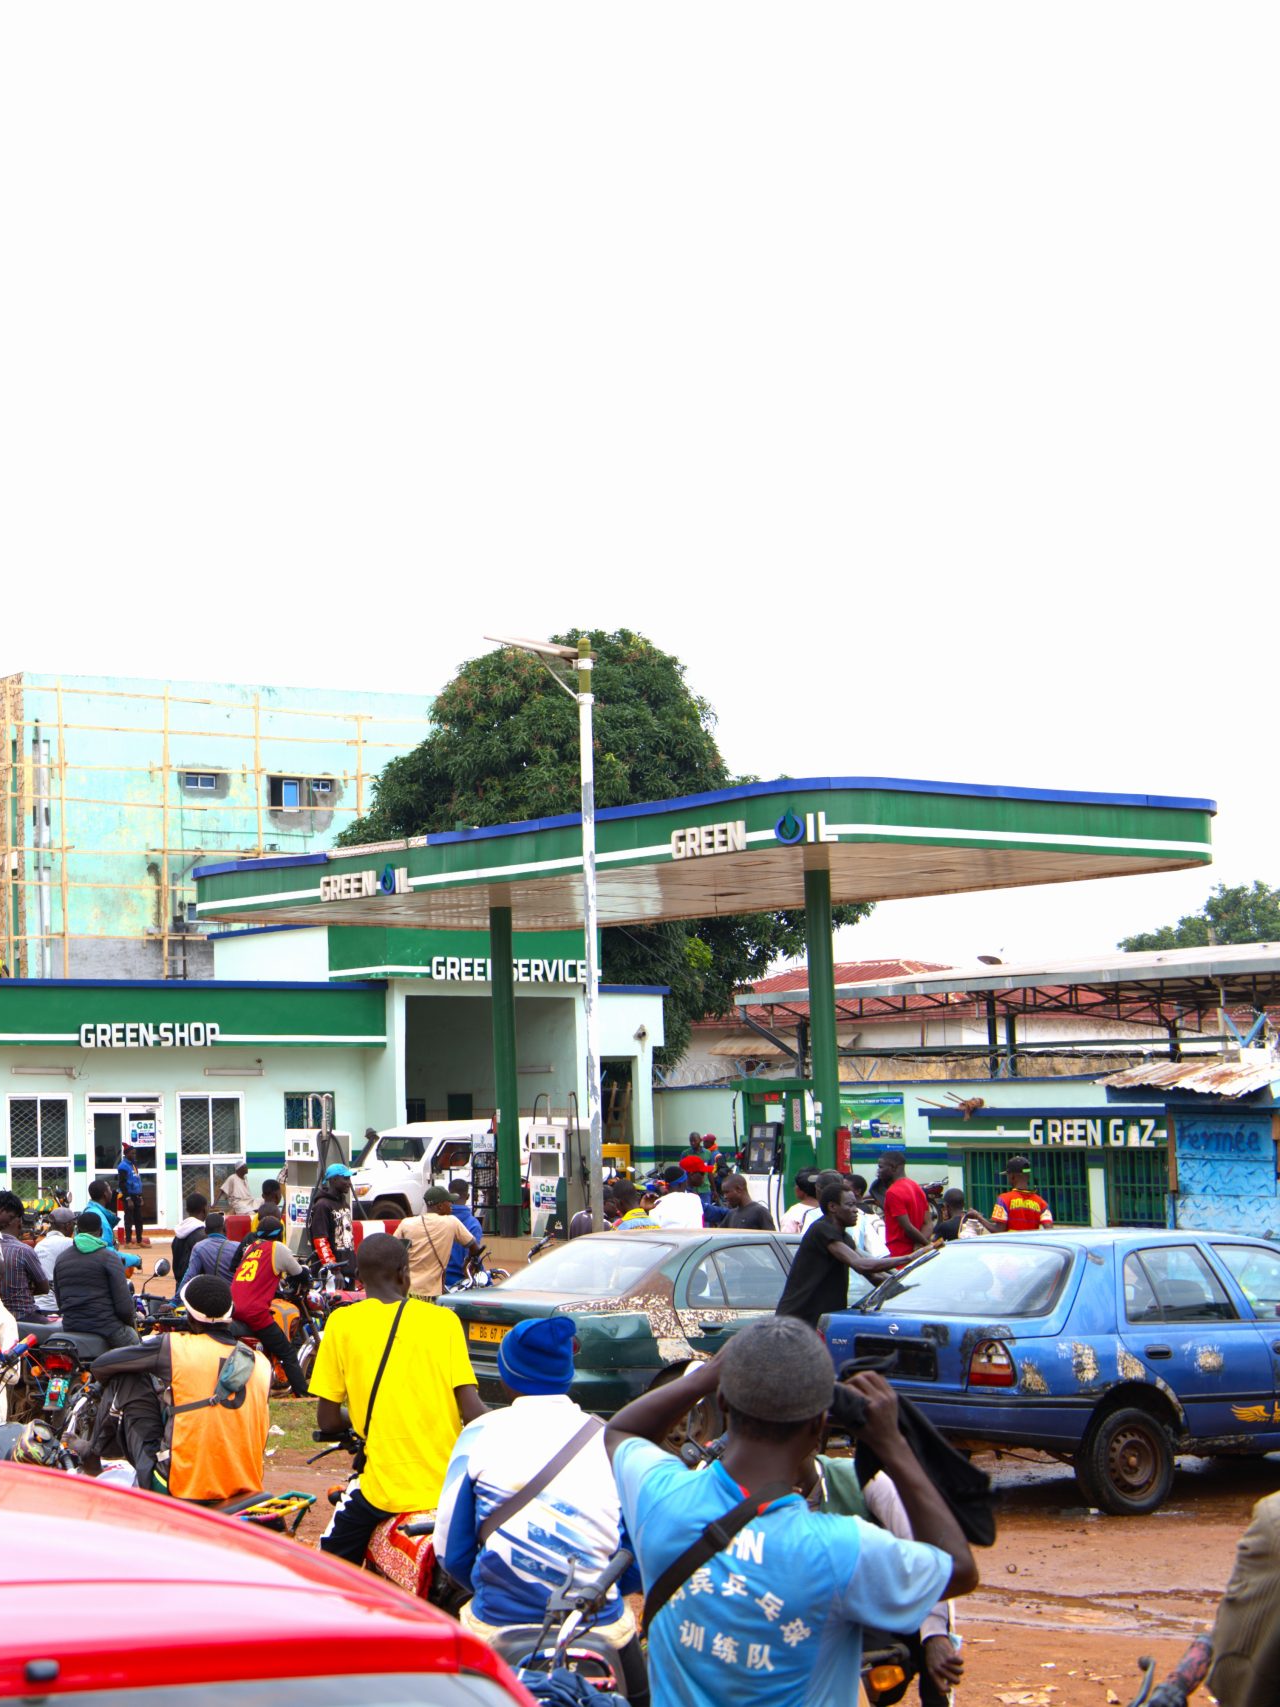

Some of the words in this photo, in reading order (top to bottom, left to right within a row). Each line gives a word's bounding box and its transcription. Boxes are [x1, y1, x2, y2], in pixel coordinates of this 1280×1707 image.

[671, 820, 747, 860] GREEN
[775, 807, 839, 845] OIL
[320, 870, 377, 902] GREEN
[380, 864, 414, 895] OIL
[431, 956, 492, 982] GREE
[80, 1022, 154, 1048] GREEN
[159, 1022, 220, 1047] SHOP
[136, 1121, 154, 1130] Gaz
[1029, 1118, 1102, 1147] GREEN
[295, 1194, 310, 1205] Gaz
[539, 1183, 555, 1193] Gaz
[236, 1259, 259, 1282] 23
[678, 1619, 775, 1672] 训练队
